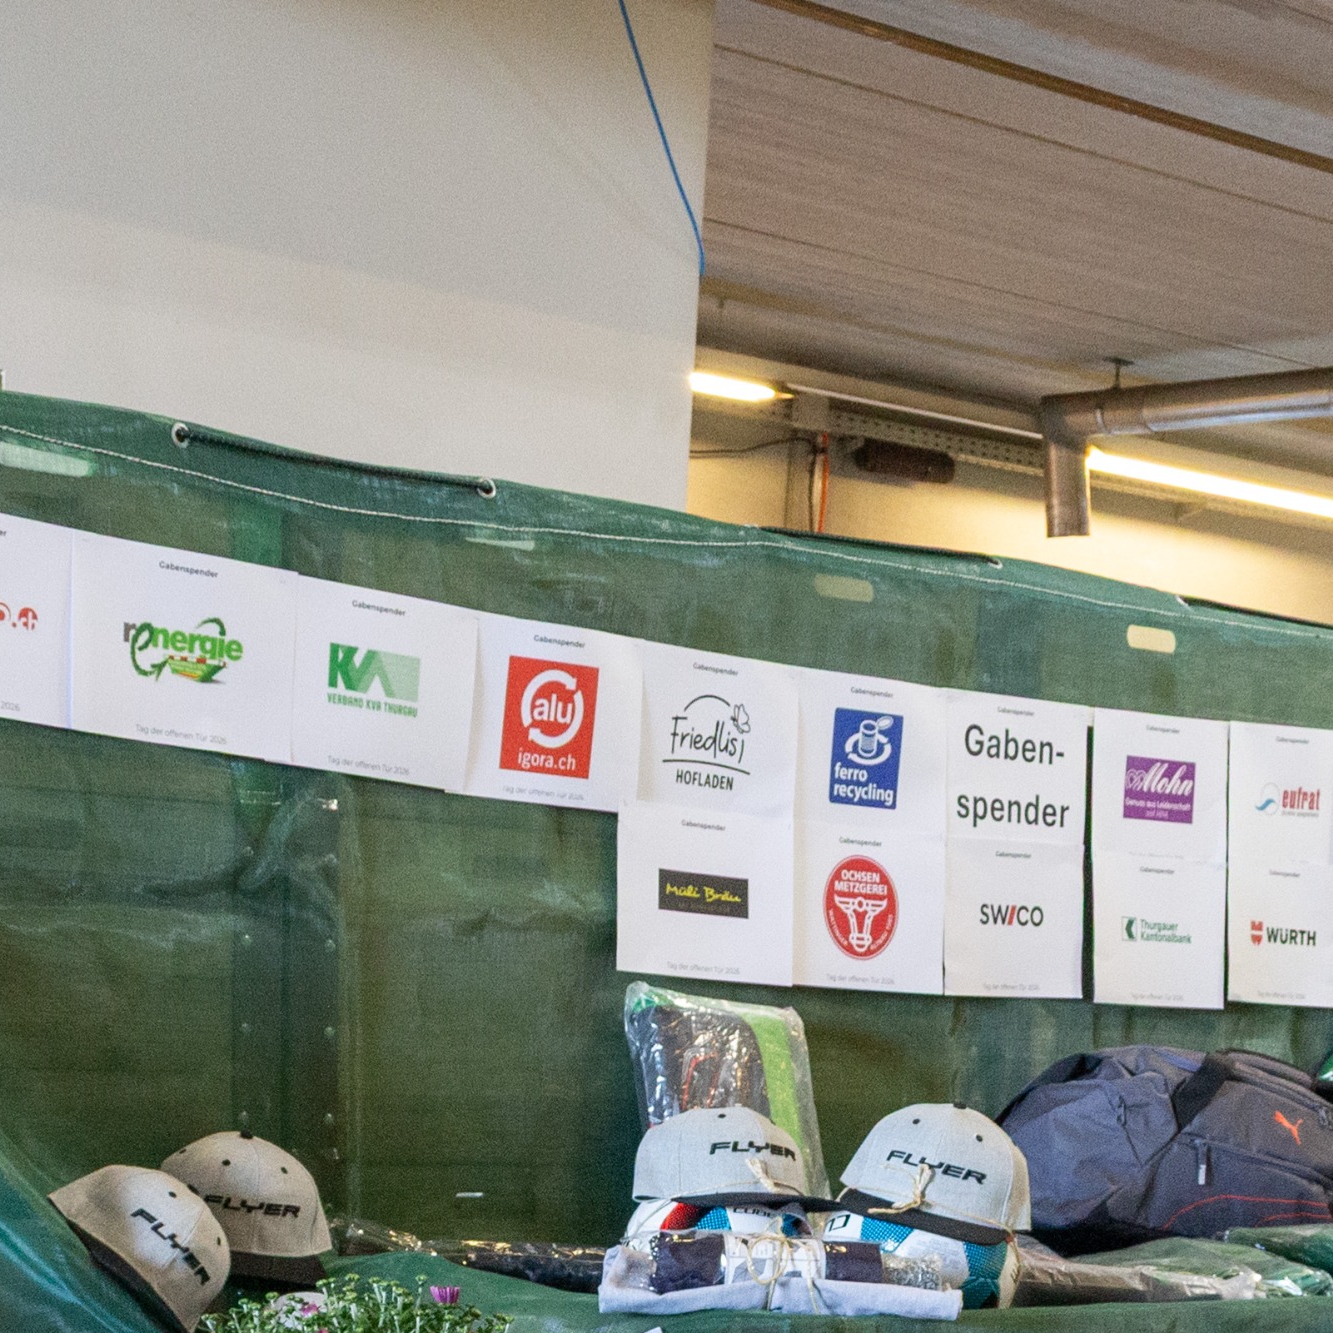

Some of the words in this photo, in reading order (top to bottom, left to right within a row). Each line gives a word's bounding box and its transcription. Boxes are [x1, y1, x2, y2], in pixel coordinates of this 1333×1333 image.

[159, 561, 218, 577] Gabenspender
[352, 600, 406, 616] Gabenspender
[534, 635, 585, 649] Gabenspender
[693, 663, 738, 676] Gabenspender
[851, 686, 894, 698] Gabenspender
[533, 693, 573, 724] alu
[965, 723, 1065, 765] Gaben-
[518, 748, 576, 771] igora.ch
[676, 769, 733, 791] HOFLADEN
[834, 762, 868, 782] ferro
[833, 783, 894, 805] recycling
[956, 794, 1070, 828] spender
[681, 819, 726, 831] Gabenspender
[841, 869, 880, 884] OCHSEN
[834, 880, 887, 895] METZGEREI
[1267, 927, 1317, 946] WÜRTH
[709, 1141, 796, 1162] FLYER
[885, 1149, 987, 1185] FLYER
[205, 1193, 301, 1219] FLYER
[132, 1206, 212, 1285] FLYER
